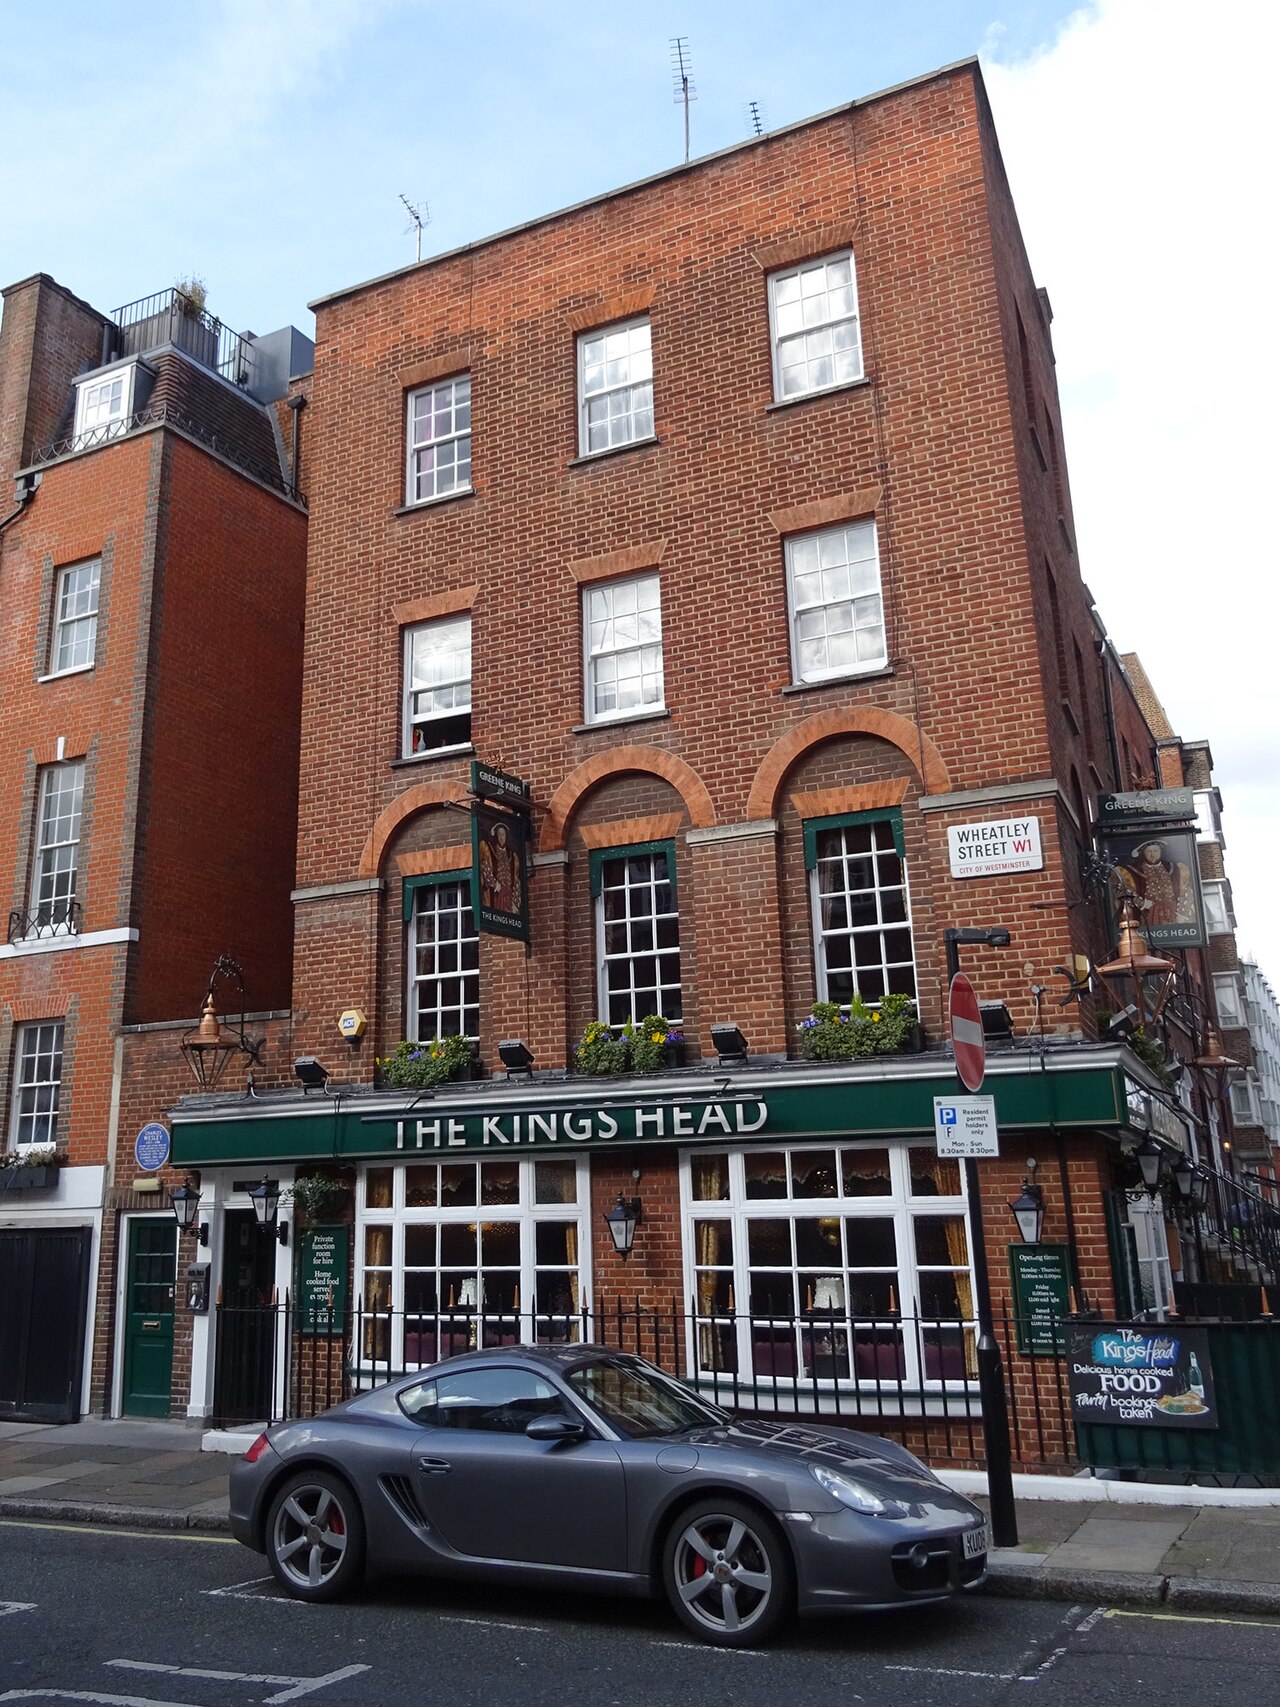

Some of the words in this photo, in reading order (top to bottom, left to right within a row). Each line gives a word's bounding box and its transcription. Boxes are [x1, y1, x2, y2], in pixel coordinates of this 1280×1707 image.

[479, 771, 504, 788] GREENE
[505, 781, 521, 795] KING
[1105, 798, 1152, 811] GREENE
[1156, 794, 1187, 805] KING
[957, 823, 1030, 843] WHEATLEY
[958, 841, 1008, 860] STREET
[1012, 839, 1032, 853] W1
[959, 867, 975, 875] CITY
[985, 860, 1030, 871] WESTMINSTER
[481, 911, 492, 921] THE
[492, 914, 508, 925] KINGS
[509, 919, 523, 928] HEAD
[1139, 930, 1168, 938] KINGS
[1170, 928, 1197, 937] HEAD
[482, 1101, 619, 1144] KINGS
[634, 1094, 769, 1137] HEAD
[942, 1109, 954, 1124] P
[946, 1126, 952, 1138] F
[314, 1235, 334, 1243] Private
[313, 1257, 321, 1265] for
[314, 1270, 332, 1278] Home
[326, 1277, 340, 1285] food
[1117, 1329, 1143, 1343] The
[1102, 1340, 1146, 1363] Kings
[1145, 1339, 1175, 1367] Head
[1073, 1364, 1112, 1375] Delicious
[1113, 1366, 1138, 1375] home
[1138, 1366, 1174, 1377] cooked
[1099, 1374, 1161, 1393] FOOD
[1075, 1392, 1108, 1411] Party
[1110, 1394, 1157, 1410] bookings
[1119, 1407, 1153, 1419] taken
